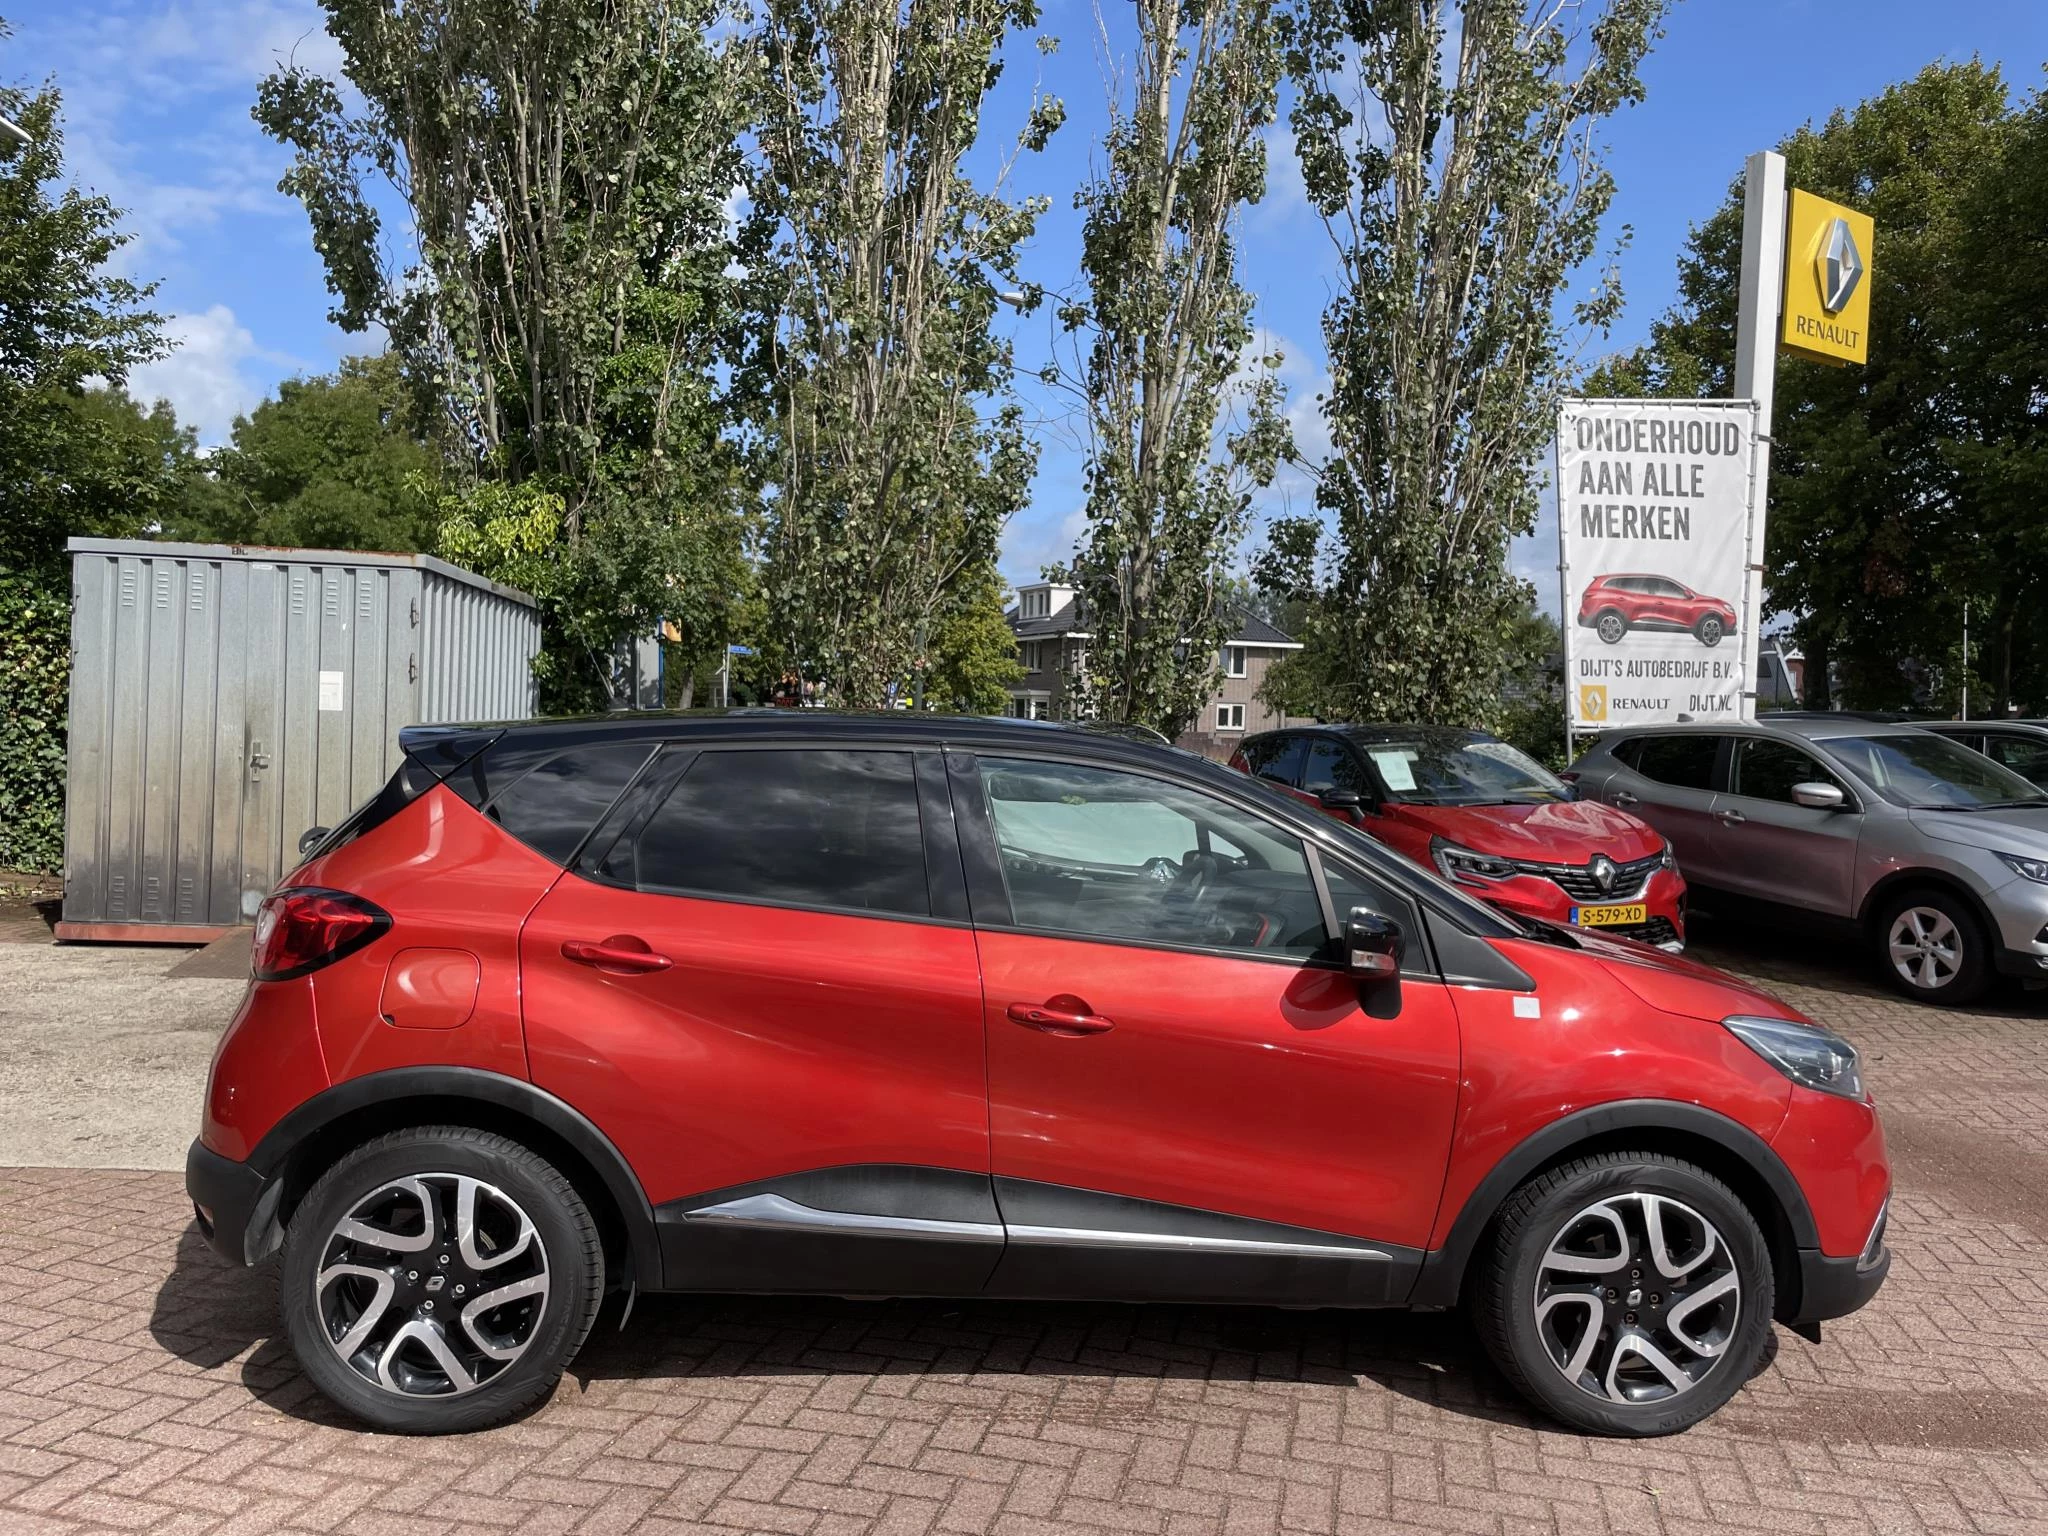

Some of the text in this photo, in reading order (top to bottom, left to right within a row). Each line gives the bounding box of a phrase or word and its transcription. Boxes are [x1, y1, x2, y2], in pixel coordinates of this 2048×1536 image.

[1796, 315, 1859, 349] RENAULT
[1576, 417, 1739, 456] ONDERHOUD
[1579, 461, 1704, 498] AAN ALLE
[1581, 504, 1690, 540] MERKEN
[1581, 659, 1733, 679] DIJT'S AUTOBEDRIJF B.V.
[1612, 698, 1670, 710] RENAULT
[1689, 694, 1732, 711] DIJT.NL
[1583, 907, 1641, 923] S-579-XD
